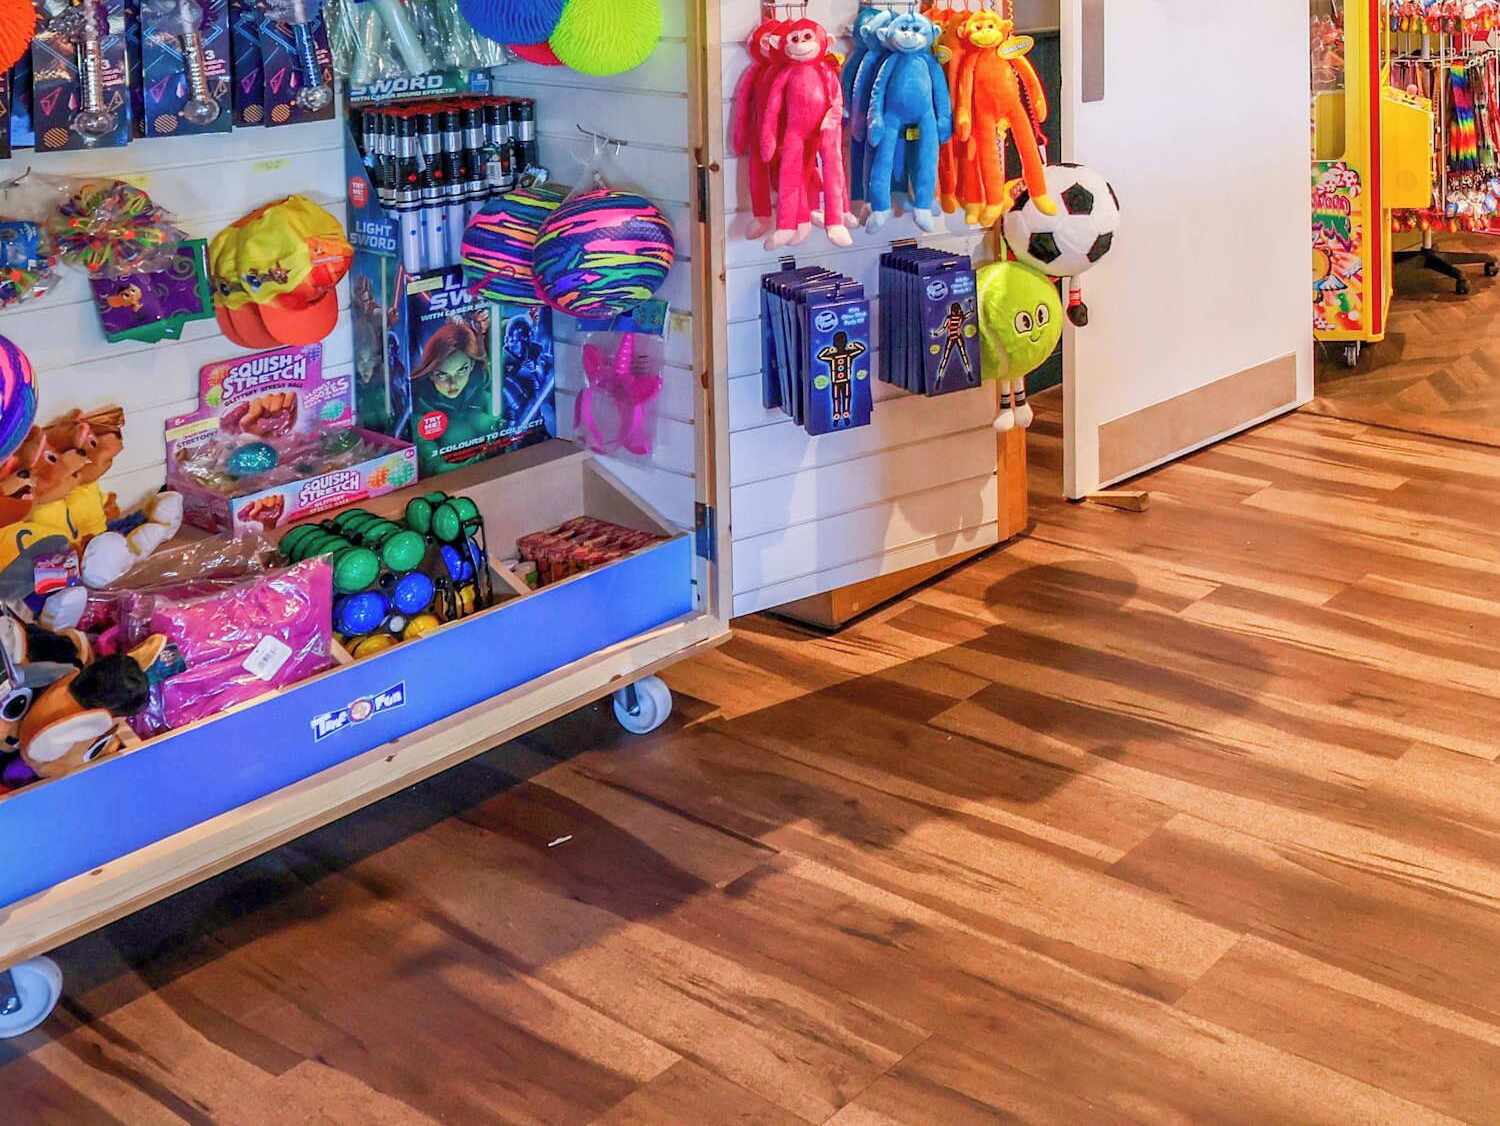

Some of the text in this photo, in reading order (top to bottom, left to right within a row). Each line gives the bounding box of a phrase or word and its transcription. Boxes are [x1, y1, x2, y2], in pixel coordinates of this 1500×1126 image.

[355, 220, 392, 237] LIGHT
[350, 232, 396, 251] SWORD
[421, 311, 444, 322] WITH
[229, 354, 292, 379] SQUISH
[222, 357, 307, 400] STRETCH
[423, 414, 442, 424] TRY
[439, 435, 485, 454] COLOURS
[486, 432, 499, 442] TO
[299, 473, 360, 507] STRETCH
[303, 471, 350, 491] SQUISH
